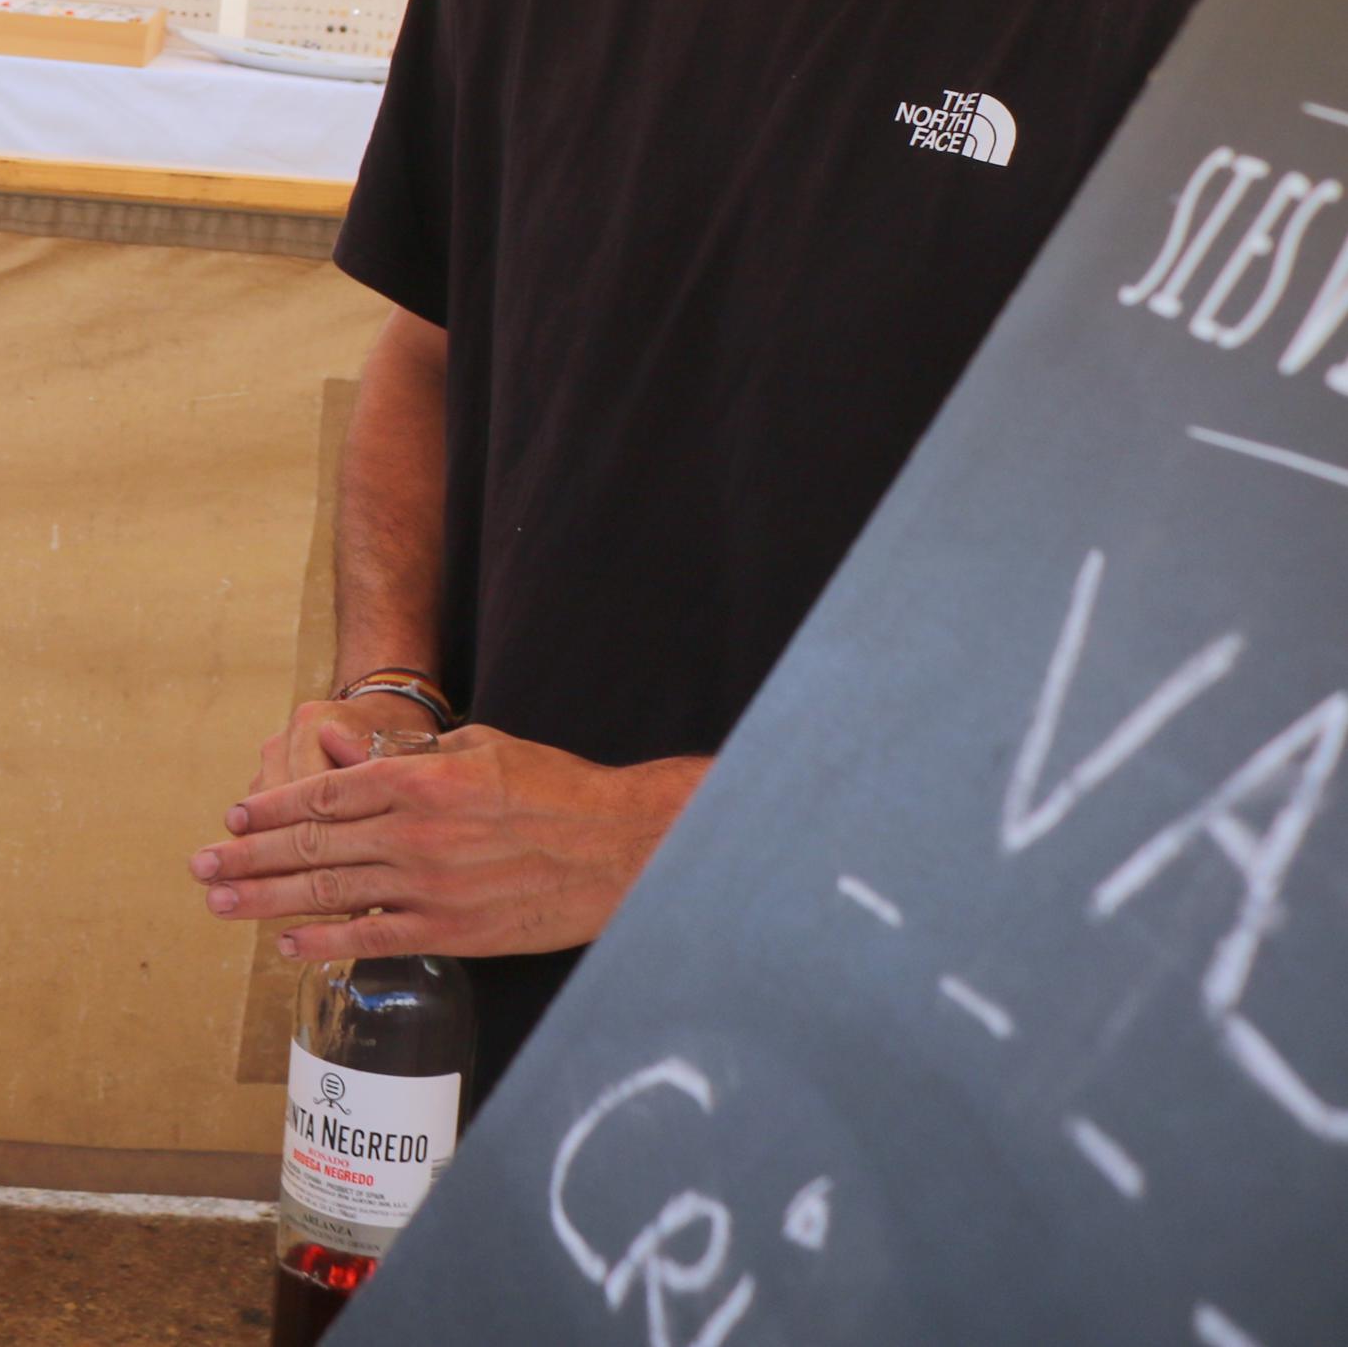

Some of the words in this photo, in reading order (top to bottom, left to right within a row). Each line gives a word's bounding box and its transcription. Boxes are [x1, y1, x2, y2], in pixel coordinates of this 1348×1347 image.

[943, 89, 981, 113] THE
[894, 102, 973, 133] NORTH
[909, 127, 966, 154] FACE
[321, 1114, 429, 1164] NEGREDO
[292, 1147, 322, 1171] BODEGA
[324, 1164, 375, 1187] NEGREDO
[308, 1147, 350, 1167] ROSADO
[304, 1213, 353, 1237] ARLANZA
